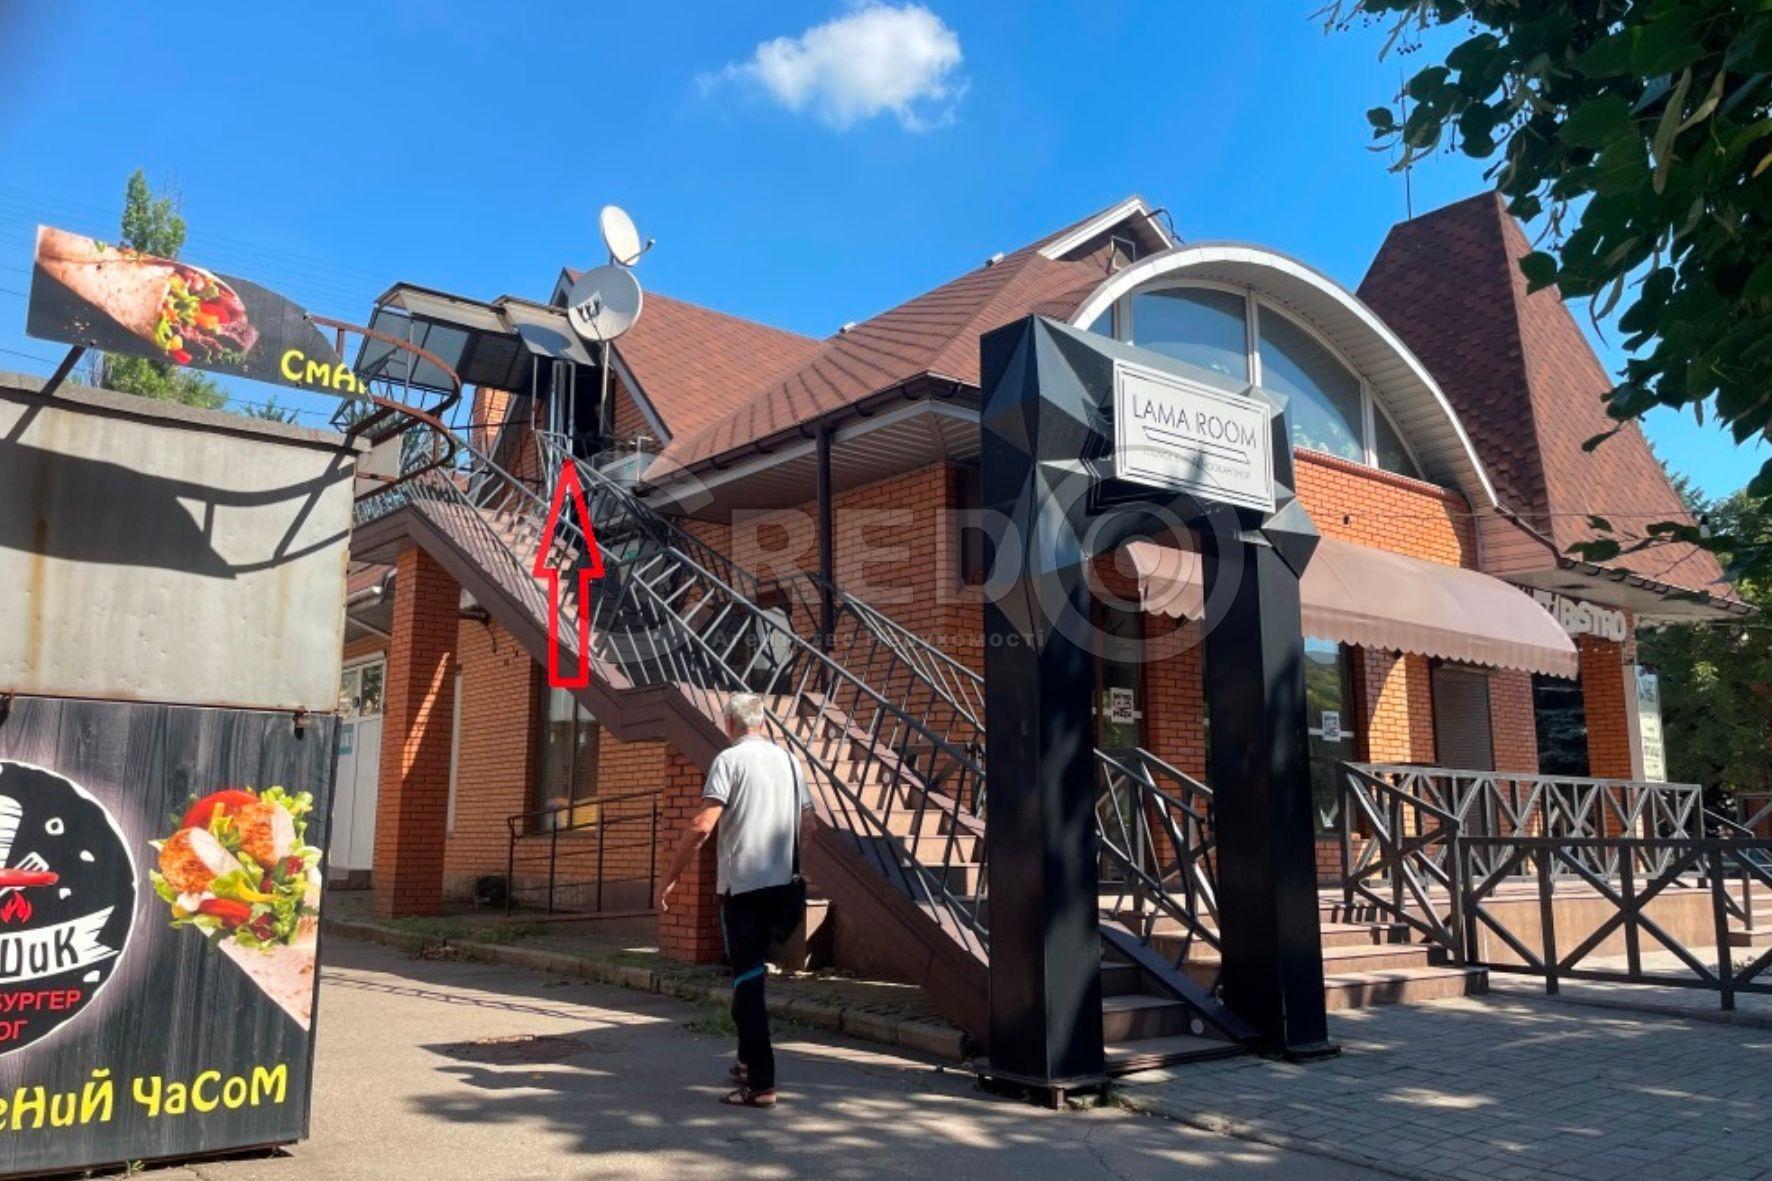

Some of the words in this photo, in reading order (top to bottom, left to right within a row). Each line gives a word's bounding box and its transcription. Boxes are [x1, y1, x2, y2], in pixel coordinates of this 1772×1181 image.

[1132, 394, 1190, 432] LAMA
[1196, 411, 1257, 449] ROOM
[0, 990, 82, 1012] УРГЕР
